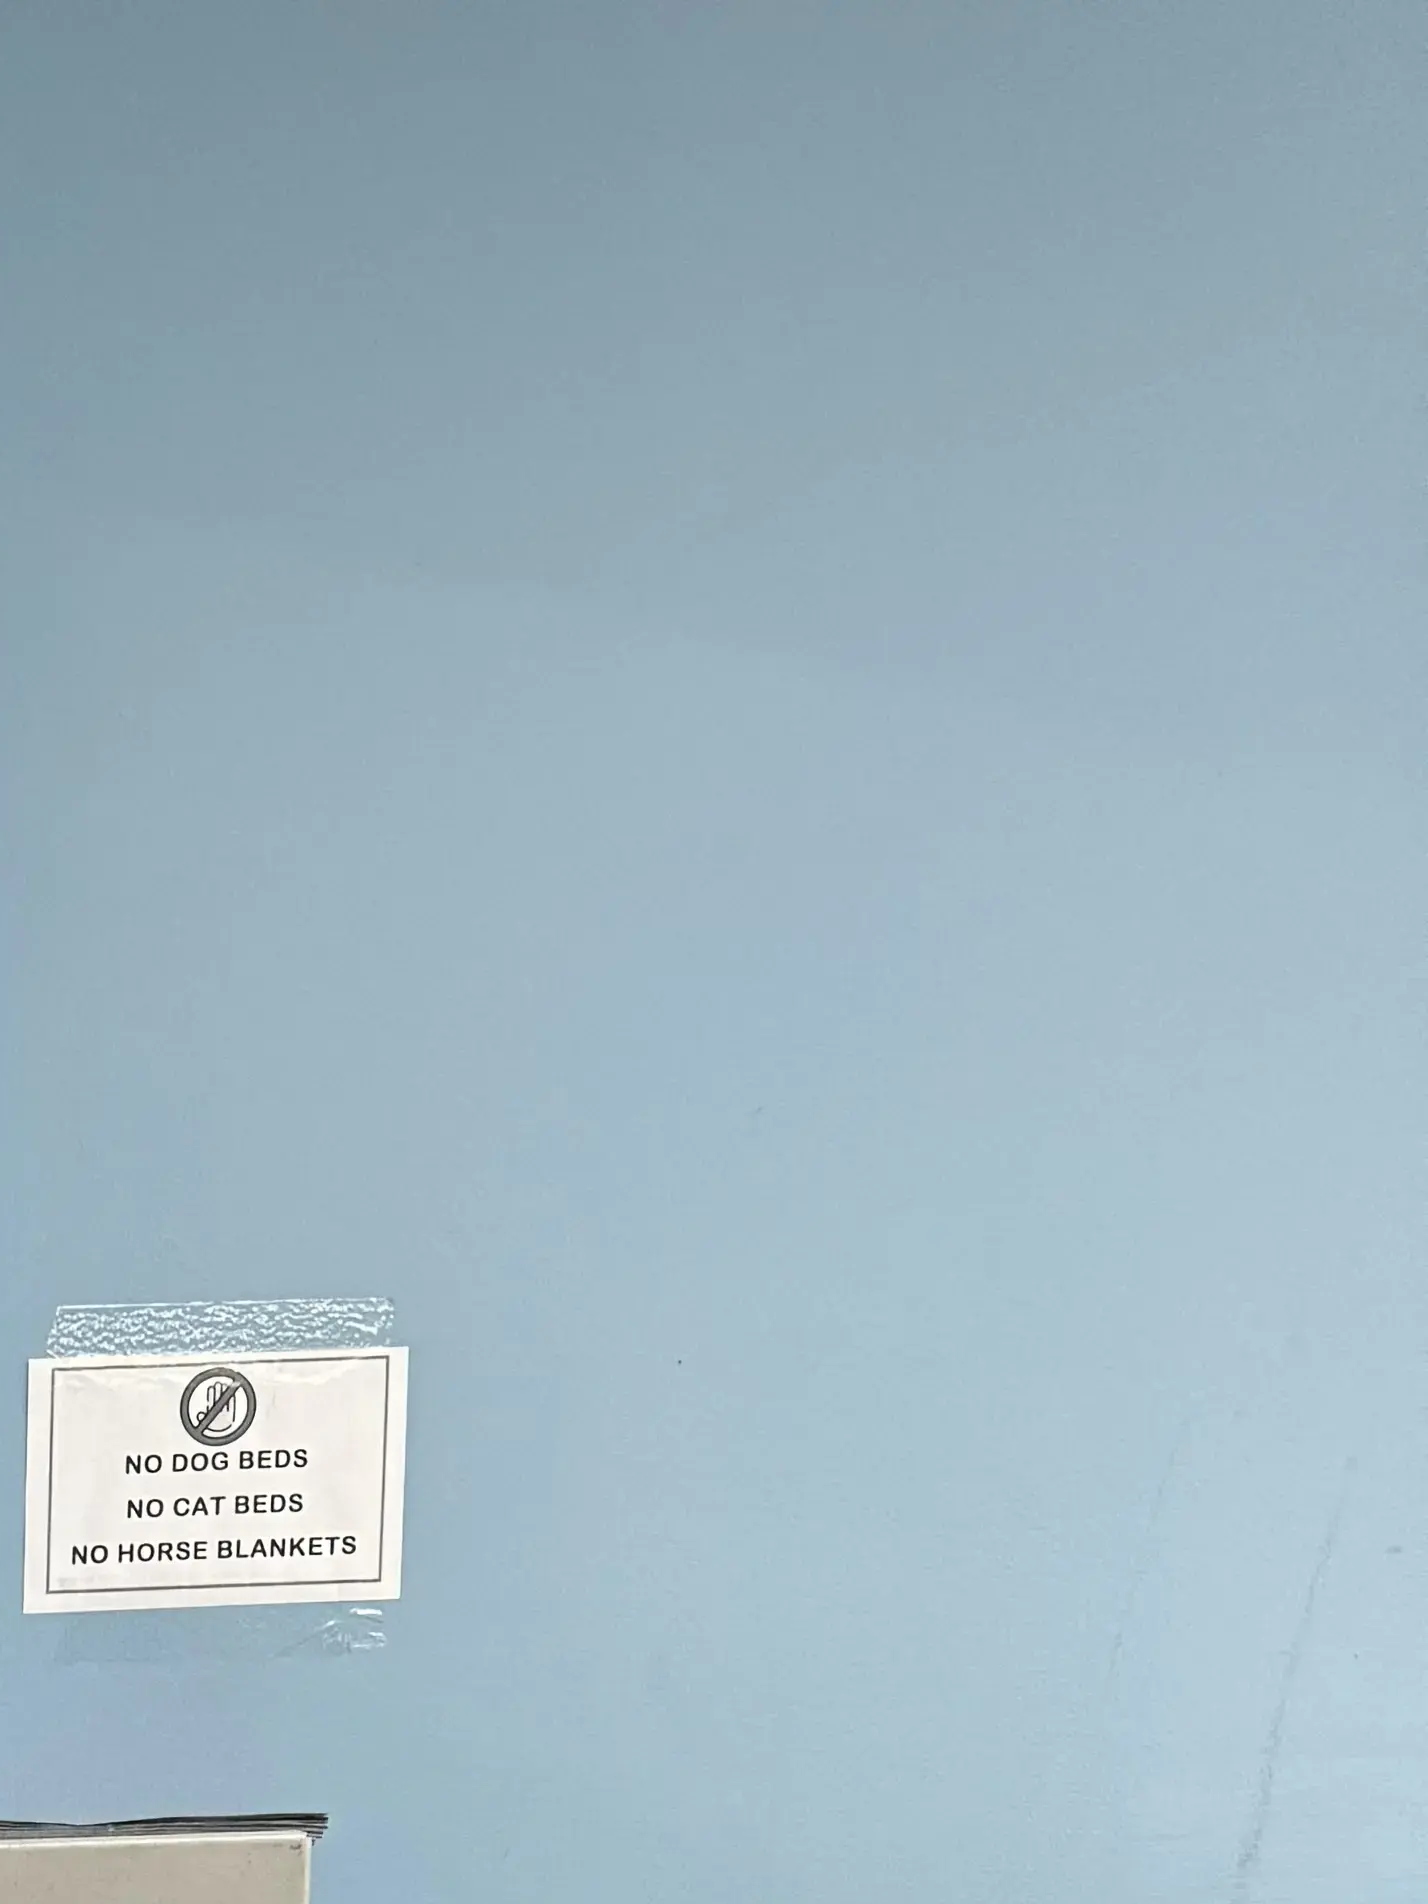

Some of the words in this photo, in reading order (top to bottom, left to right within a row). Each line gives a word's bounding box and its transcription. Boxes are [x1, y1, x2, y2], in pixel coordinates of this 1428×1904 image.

[126, 1455, 162, 1474] NO
[173, 1452, 228, 1472] DOG
[240, 1449, 307, 1469] BEDS
[128, 1499, 163, 1518] NO
[174, 1496, 226, 1516] CAT
[235, 1494, 303, 1514] BEDS
[72, 1545, 108, 1564] NO
[119, 1542, 207, 1563] HORSE
[218, 1536, 356, 1558] BLANKETS
